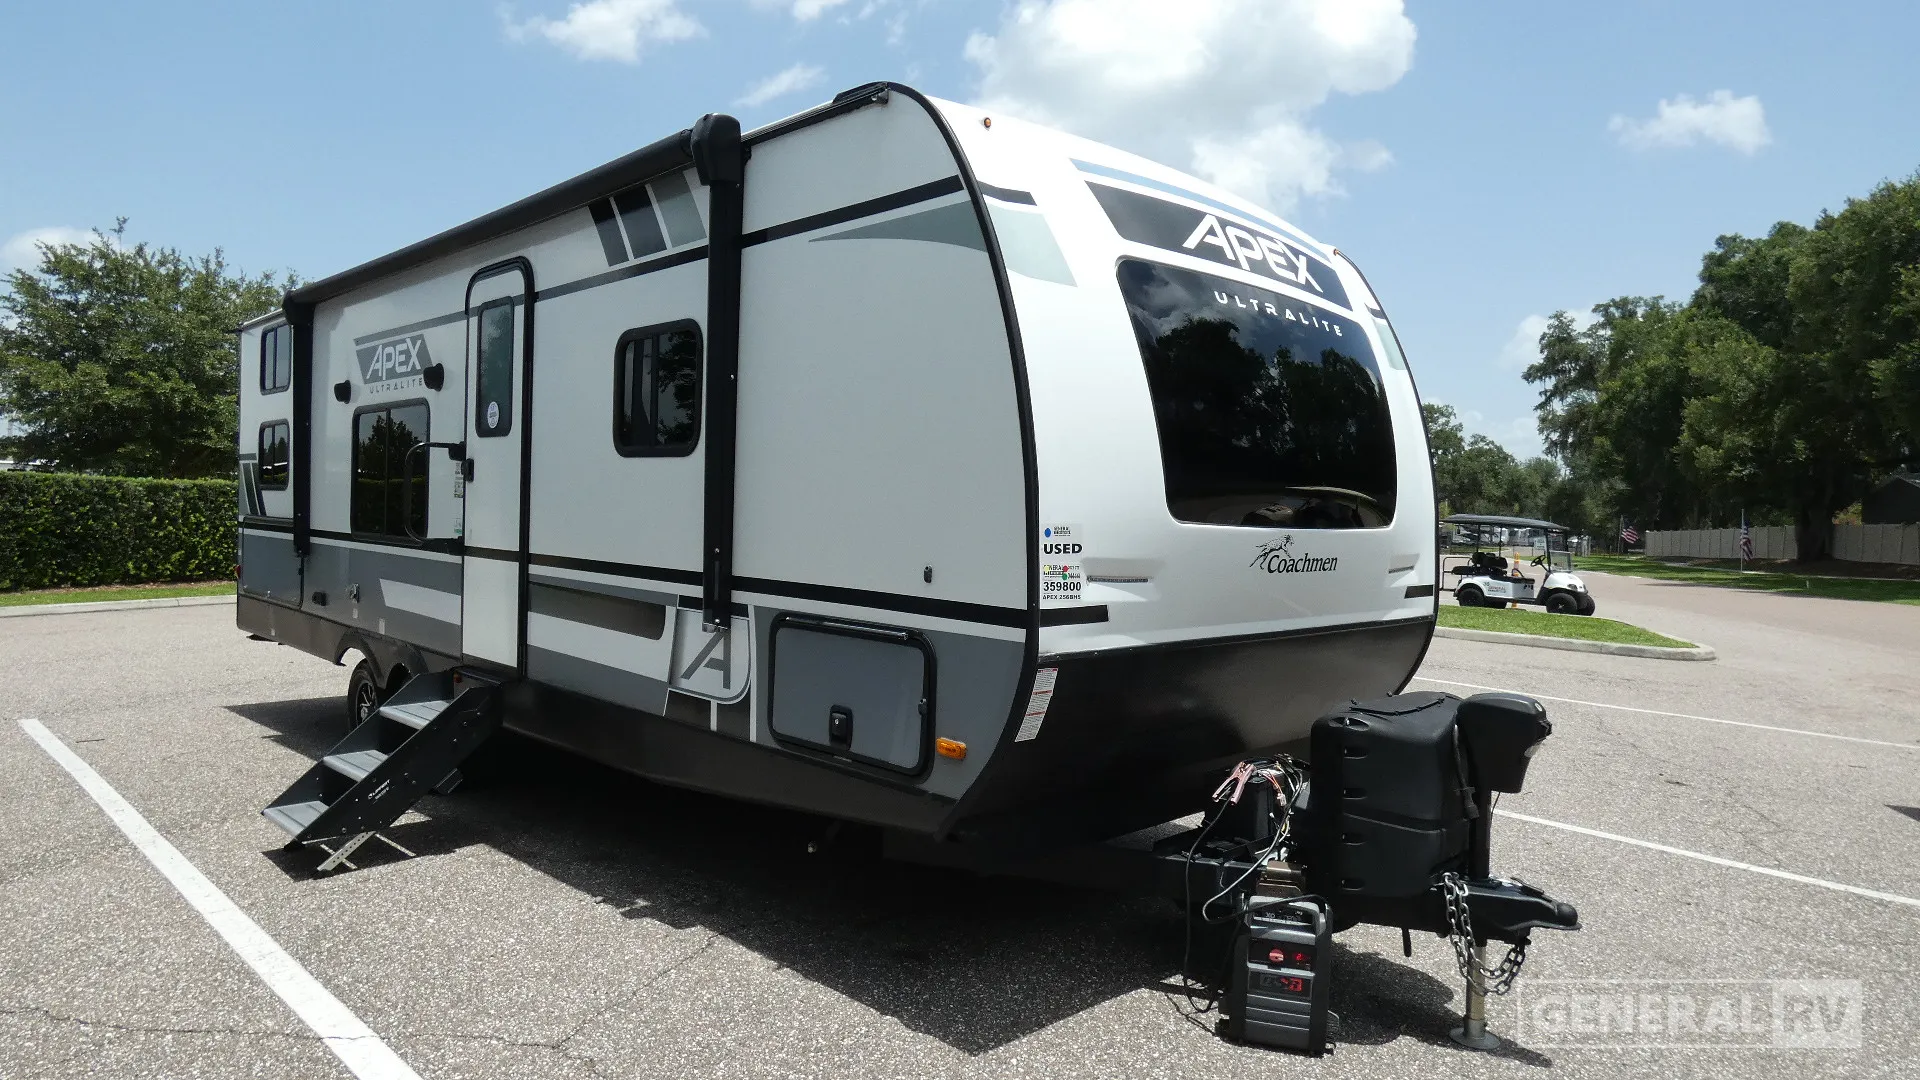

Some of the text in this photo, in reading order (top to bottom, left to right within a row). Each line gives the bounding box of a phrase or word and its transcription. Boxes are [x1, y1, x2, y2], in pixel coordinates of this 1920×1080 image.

[1182, 214, 1323, 293] APEX
[1214, 291, 1342, 337] ULTRALITE
[366, 338, 421, 380] APEX
[369, 377, 422, 394] ULTRALITE
[1043, 543, 1083, 554] USED
[1267, 552, 1338, 573] Coachmen
[1043, 581, 1081, 591] 359800
